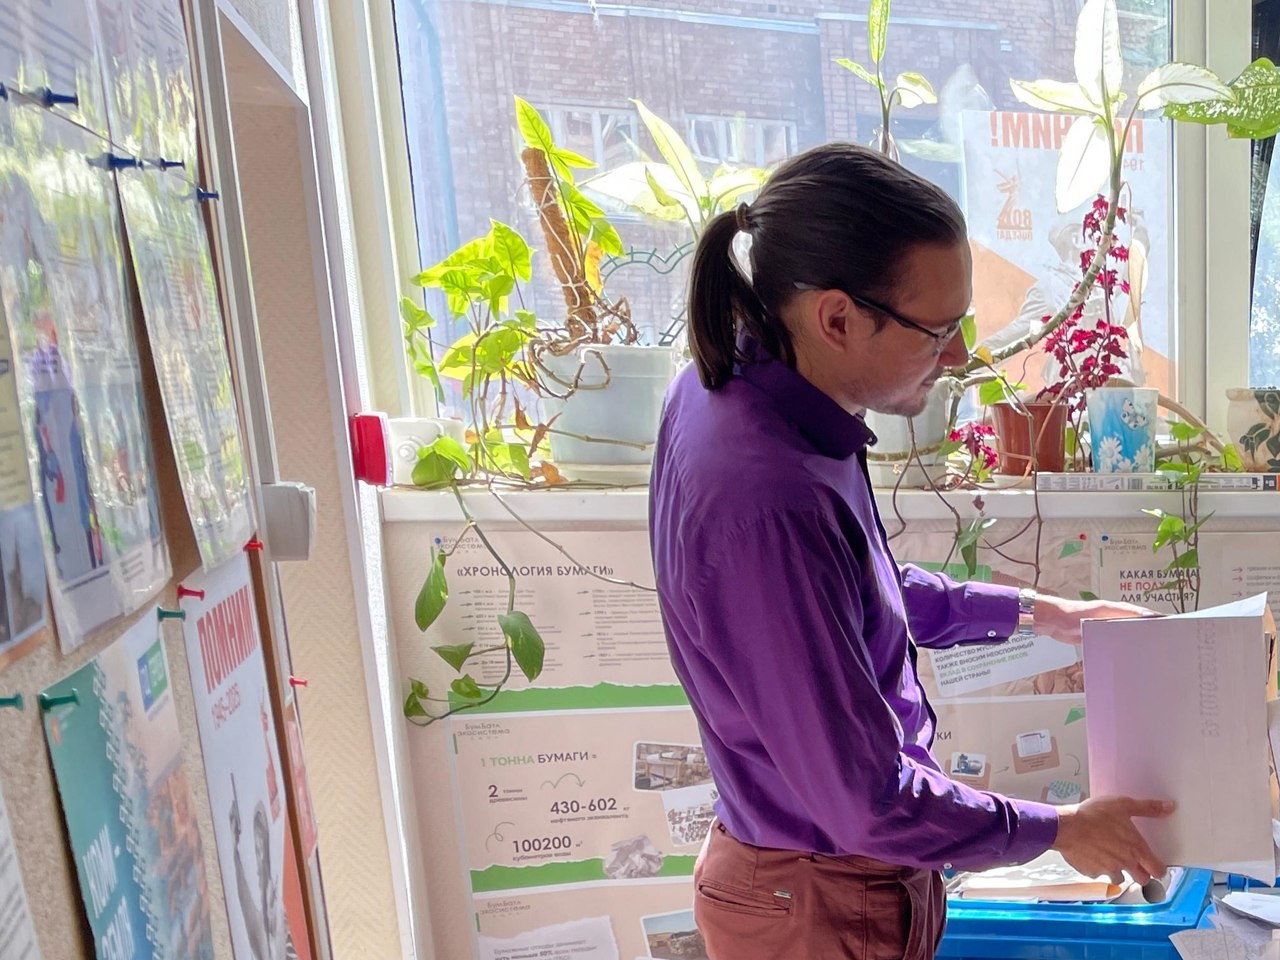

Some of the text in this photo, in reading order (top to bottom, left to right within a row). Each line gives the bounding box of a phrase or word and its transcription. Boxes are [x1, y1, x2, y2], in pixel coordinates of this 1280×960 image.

[557, 565, 614, 577] БУМАГИ»
[1120, 570, 1154, 579] КАКАЯ
[1120, 582, 1132, 591] НЕ
[196, 583, 258, 695] ПОМНИМ!
[480, 757, 486, 768] 1
[490, 755, 535, 767] ТОННА
[538, 751, 589, 764] БУМАГИ
[488, 784, 498, 798] 2
[550, 797, 618, 815] 430-602
[512, 835, 572, 854] 100200
